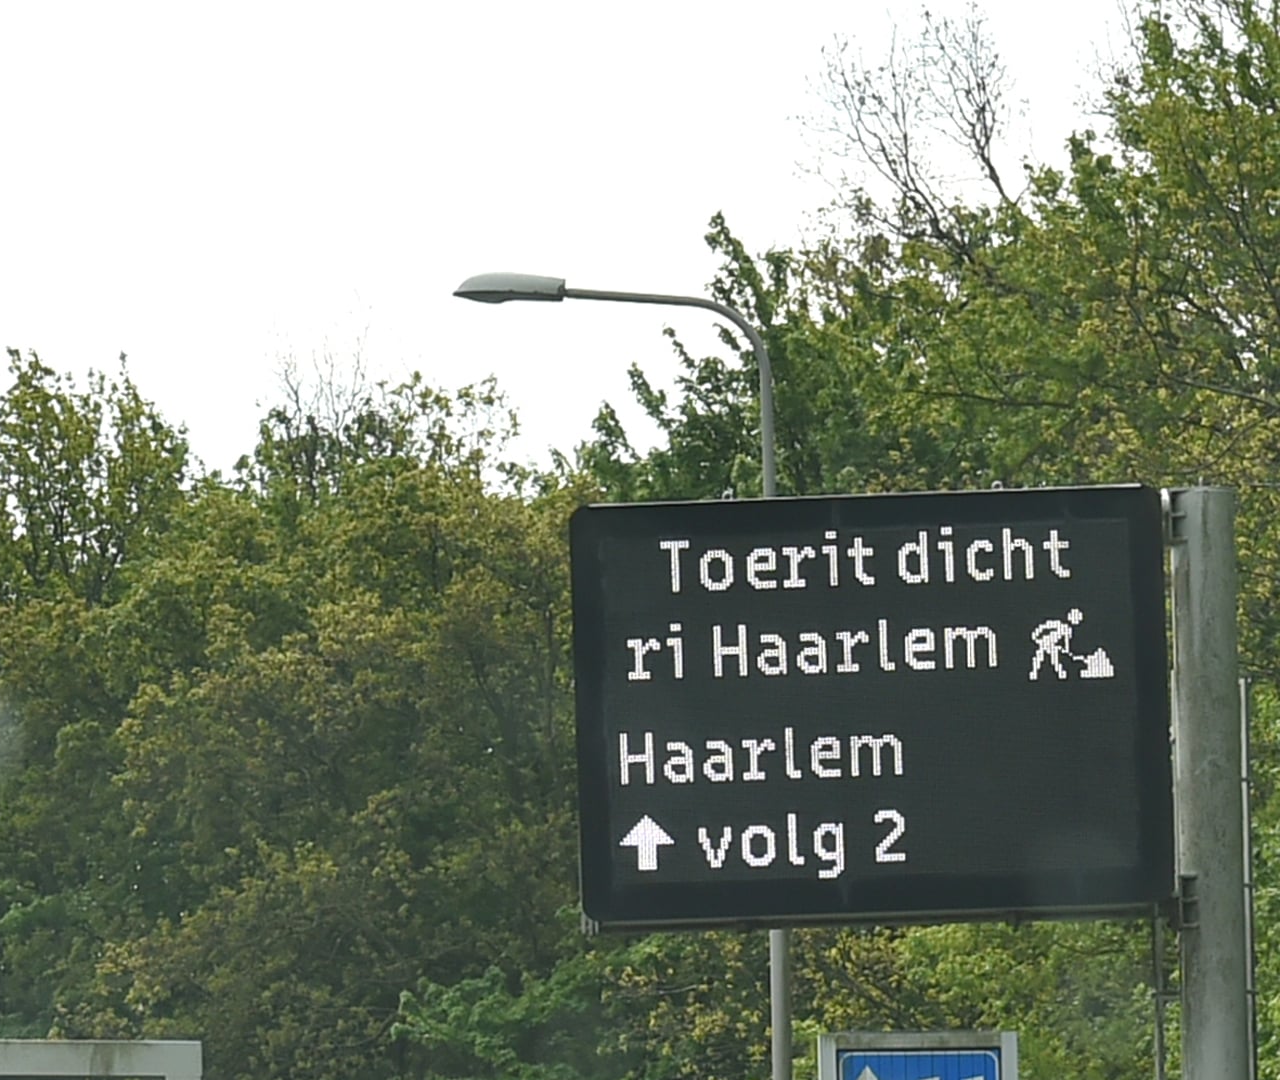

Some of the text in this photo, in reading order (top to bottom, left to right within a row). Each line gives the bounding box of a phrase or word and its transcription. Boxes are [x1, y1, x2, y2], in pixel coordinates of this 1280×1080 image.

[659, 526, 1070, 592] Toerit dicht
[627, 618, 998, 680] ri Haarlem
[619, 726, 904, 785] Haarlem
[697, 809, 906, 879] volg 2
